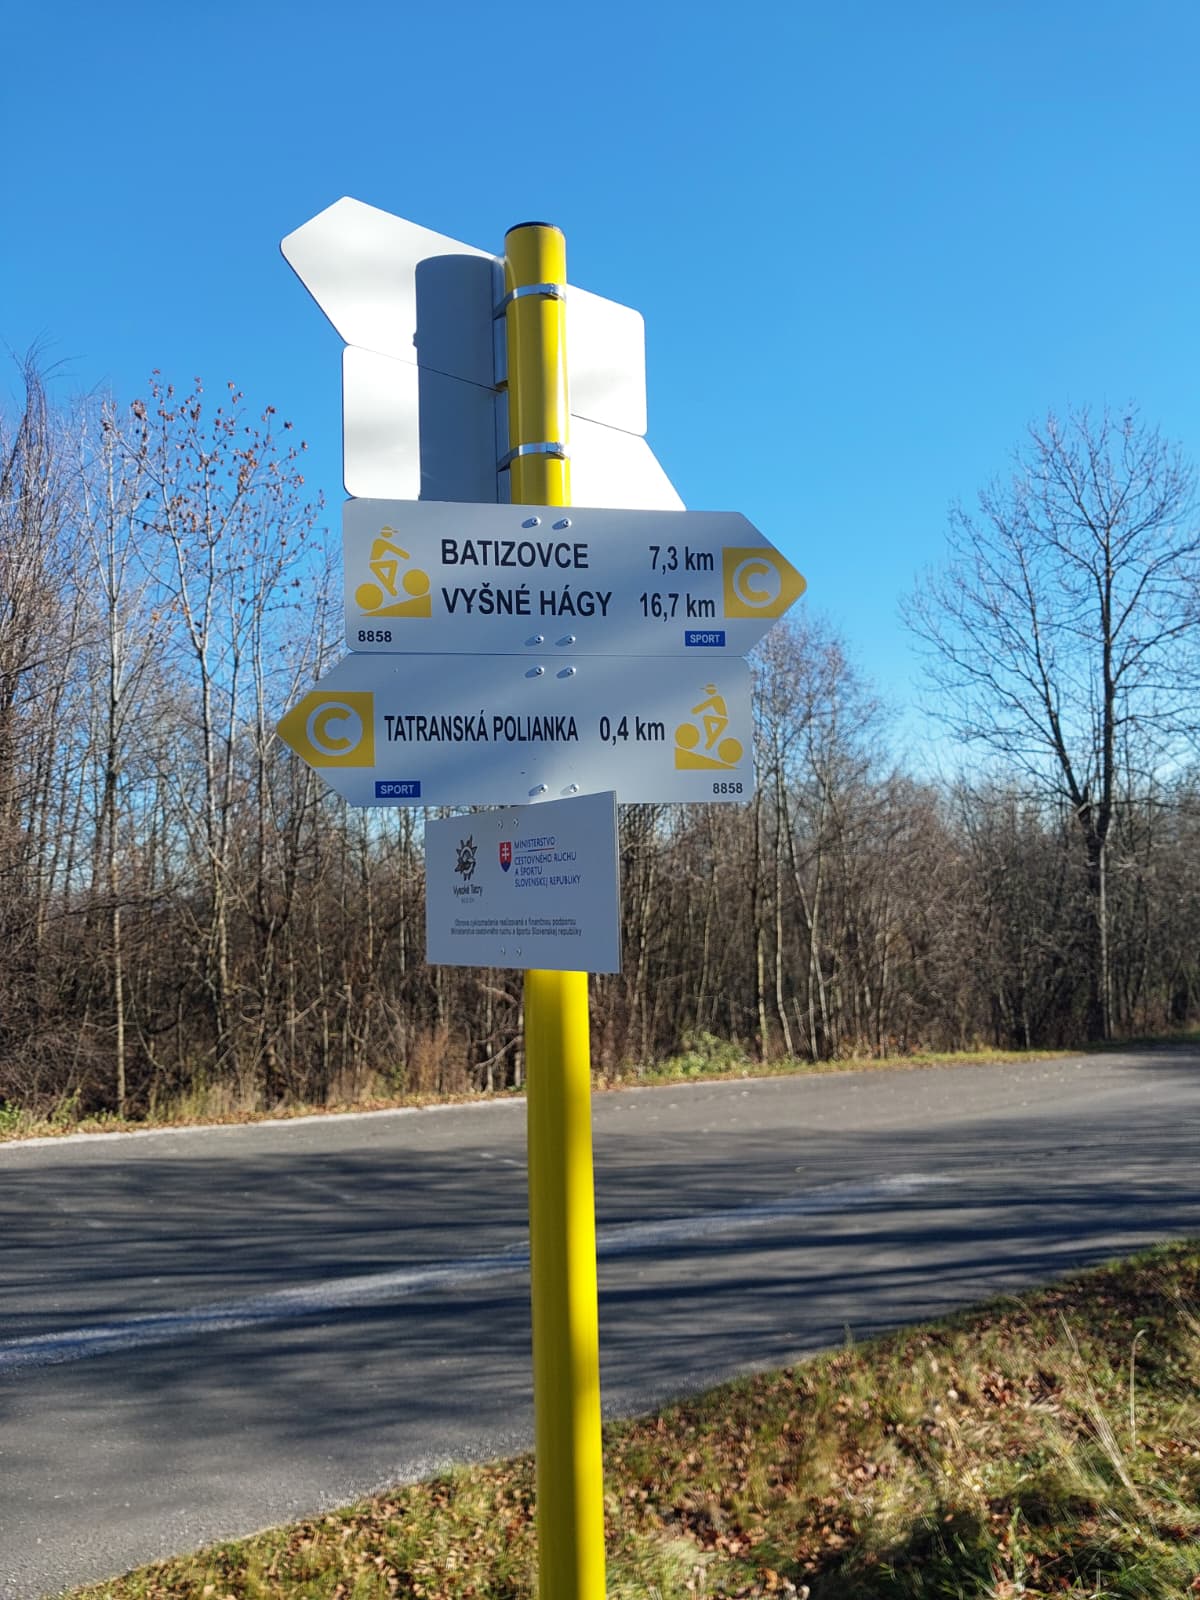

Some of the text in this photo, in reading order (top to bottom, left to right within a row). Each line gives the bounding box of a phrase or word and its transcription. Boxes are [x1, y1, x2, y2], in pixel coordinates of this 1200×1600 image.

[441, 538, 714, 572] BATIZOVCE 7,3 km
[441, 587, 716, 620] VYŠNÉ HÁGY 16,7 km
[357, 630, 393, 643] 8858
[689, 634, 721, 645] SPORT
[384, 709, 665, 746] TATRANSKÁ POLIANKA 0,4 km
[380, 784, 415, 796] SPORT
[712, 782, 744, 794] 8858
[514, 836, 556, 849] MINISTERSTVO
[514, 851, 577, 866] CESTOVNÉHO RUCHU
[514, 875, 581, 888] SLOVENSKEJ REPUBLIKY
